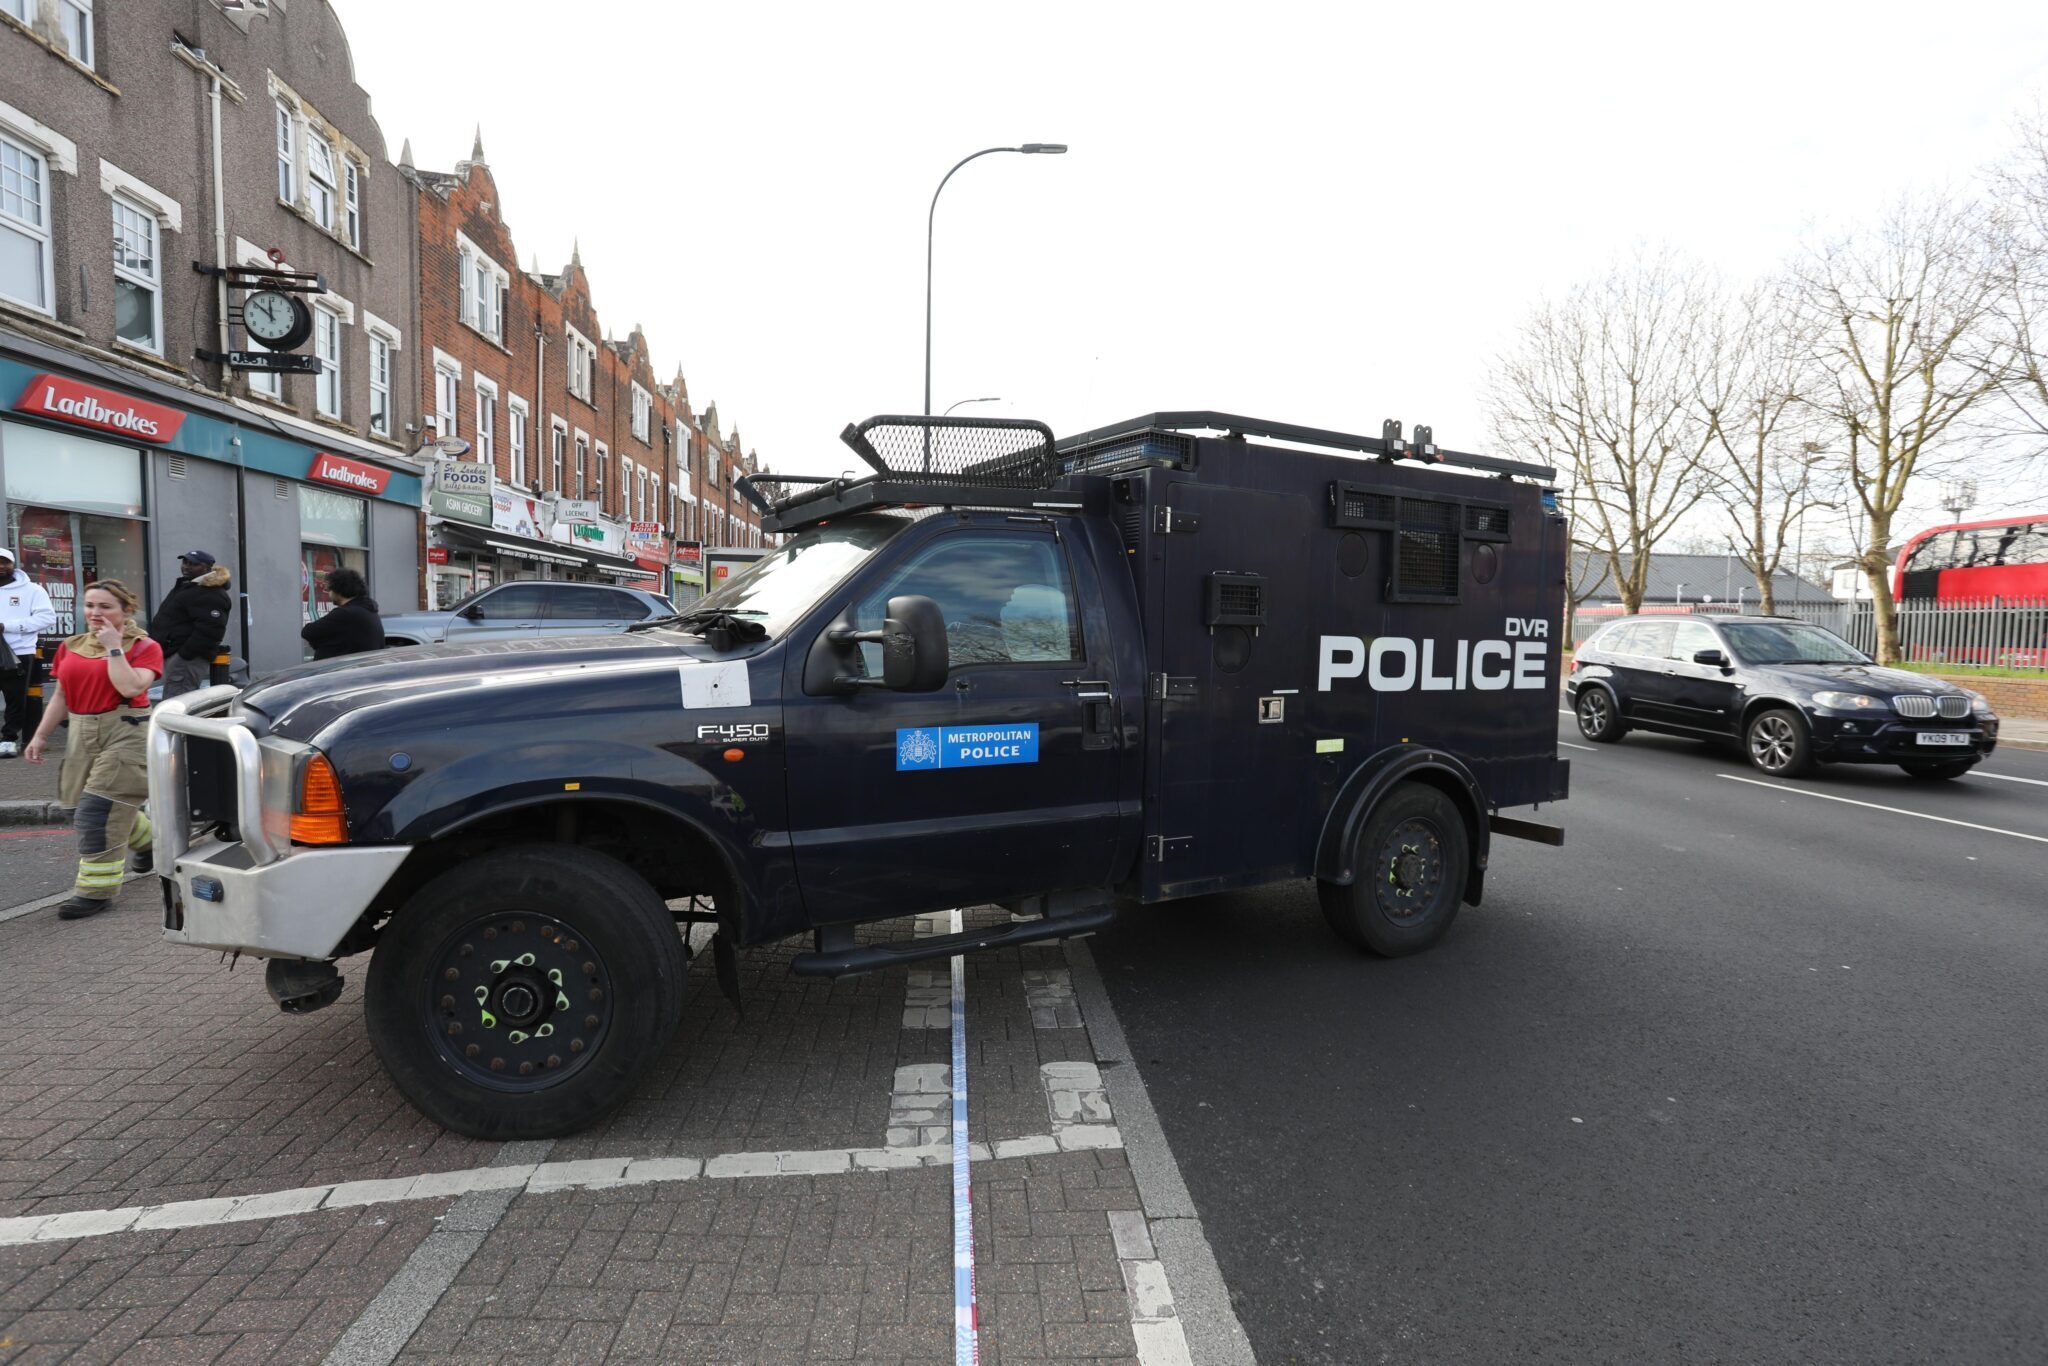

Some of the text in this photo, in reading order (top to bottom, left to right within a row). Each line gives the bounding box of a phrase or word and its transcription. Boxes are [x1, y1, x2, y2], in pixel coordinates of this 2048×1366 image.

[43, 385, 159, 436] Ladbrokes
[320, 460, 378, 491] Ladbrokes
[444, 463, 487, 475] Sri Lankan
[443, 473, 487, 484] FOODS
[445, 498, 483, 517] ASIAN GROCERY
[565, 510, 589, 518] LICENCE
[46, 583, 75, 598] YOUR
[51, 599, 73, 612] URITE
[1505, 617, 1549, 638] DVR
[1318, 635, 1548, 692] POLICE
[947, 730, 1032, 744] METROPOLITAN
[960, 745, 1021, 761] POLICE
